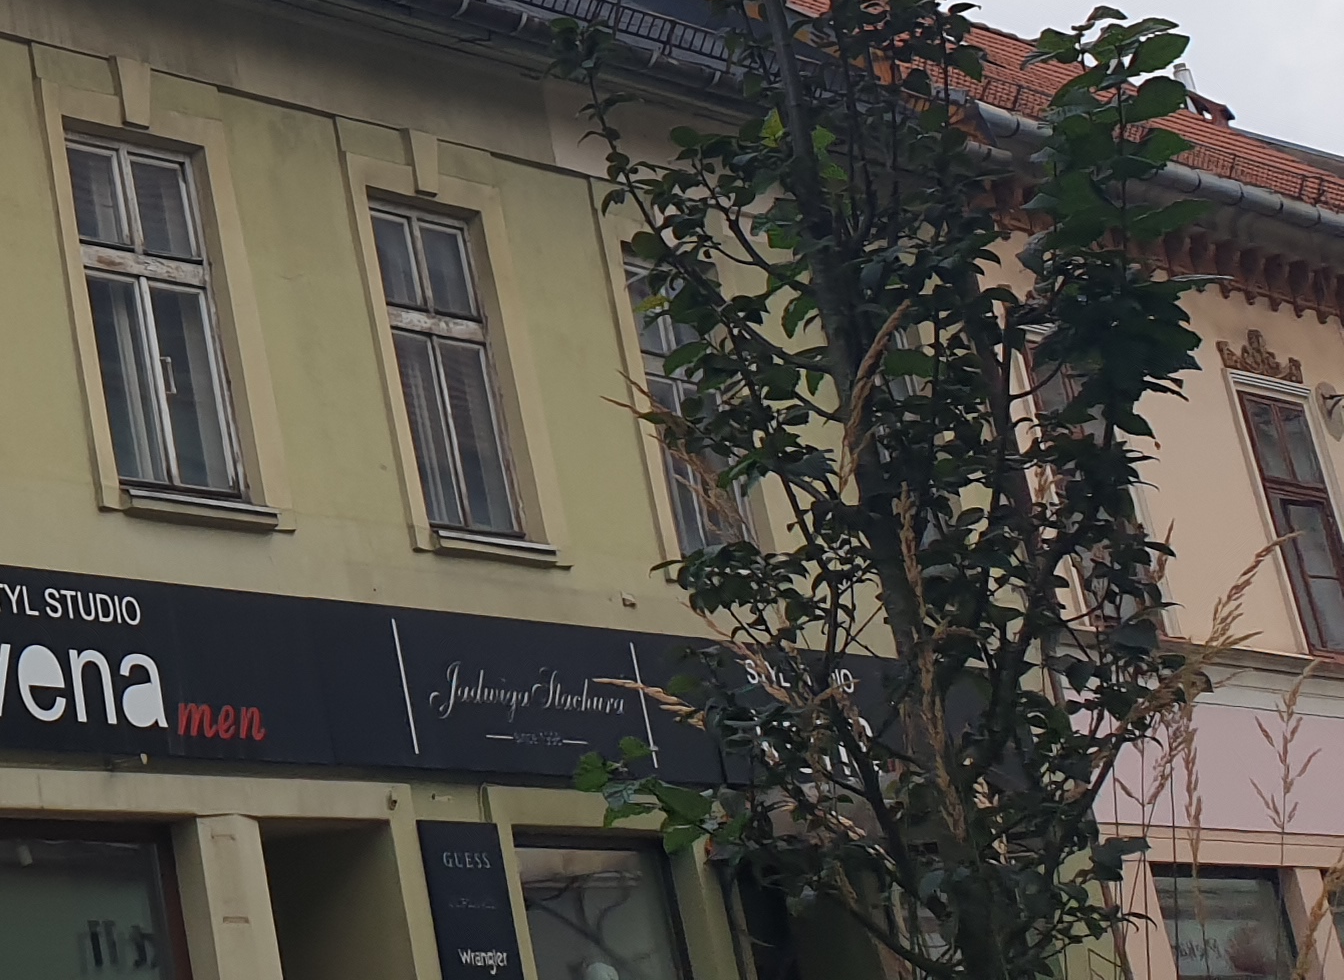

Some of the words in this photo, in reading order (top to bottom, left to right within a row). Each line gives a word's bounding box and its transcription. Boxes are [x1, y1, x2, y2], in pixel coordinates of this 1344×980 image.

[44, 587, 142, 626] STUDIO
[177, 702, 267, 741] men
[457, 948, 508, 975] Wrangler
